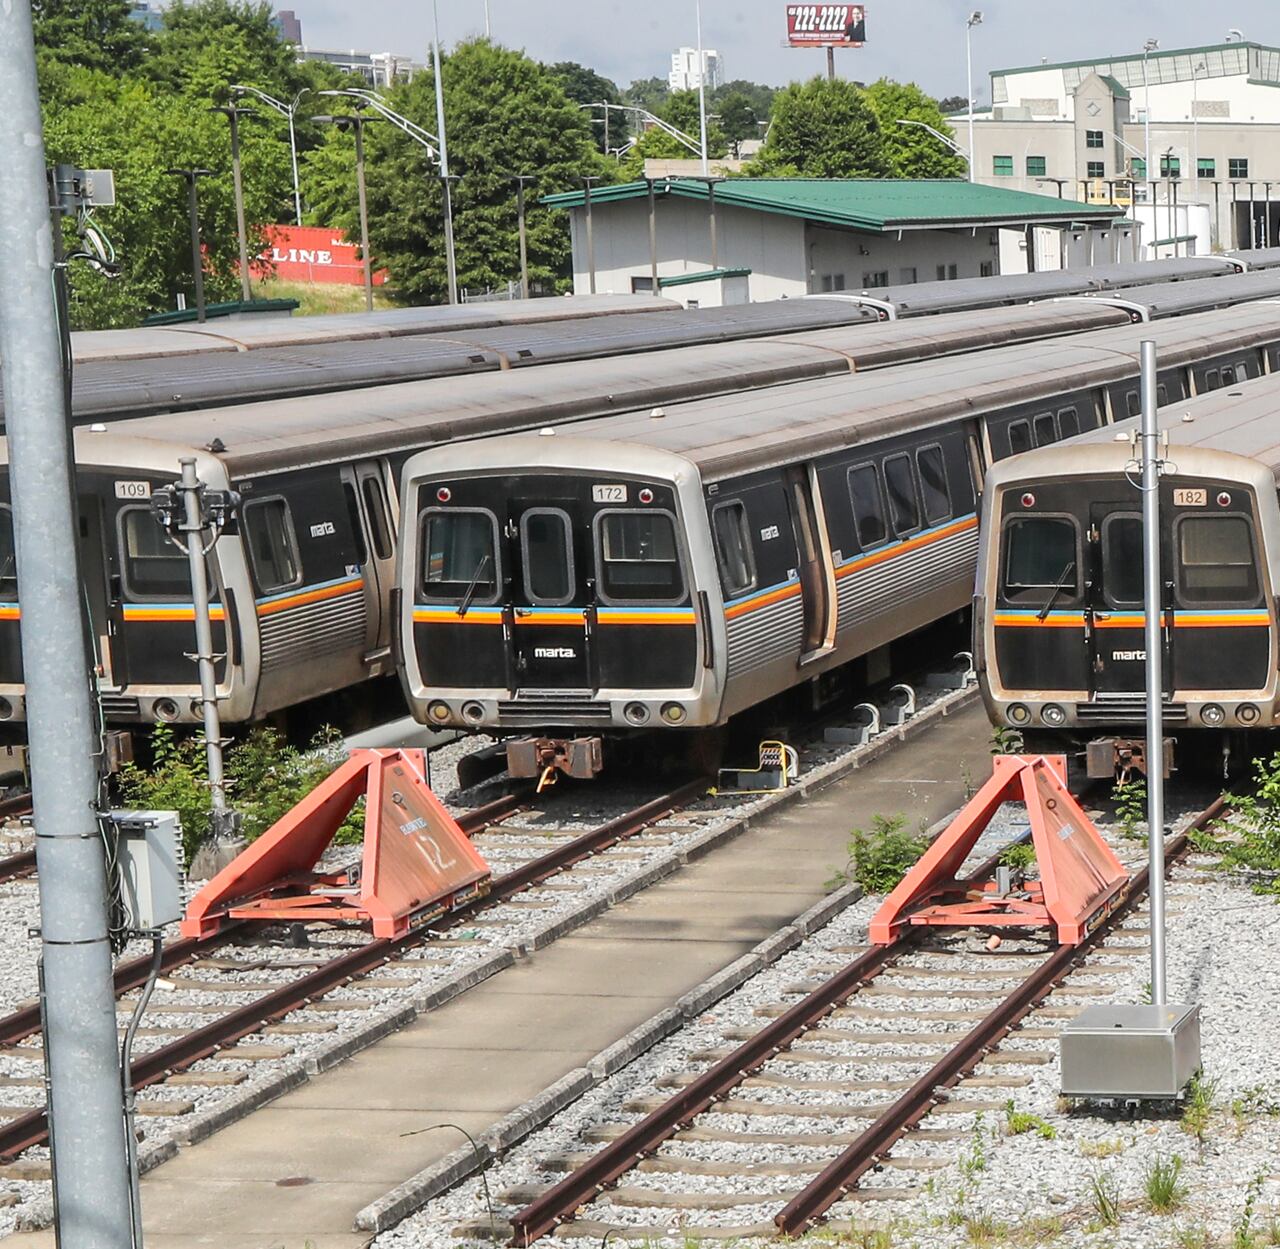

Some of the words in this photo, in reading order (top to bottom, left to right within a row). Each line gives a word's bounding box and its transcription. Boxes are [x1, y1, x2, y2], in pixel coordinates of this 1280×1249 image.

[794, 6, 848, 31] 222-2222
[272, 247, 332, 264] LINE
[119, 483, 146, 496] 109
[597, 487, 623, 500] 172
[1178, 491, 1203, 504] 182
